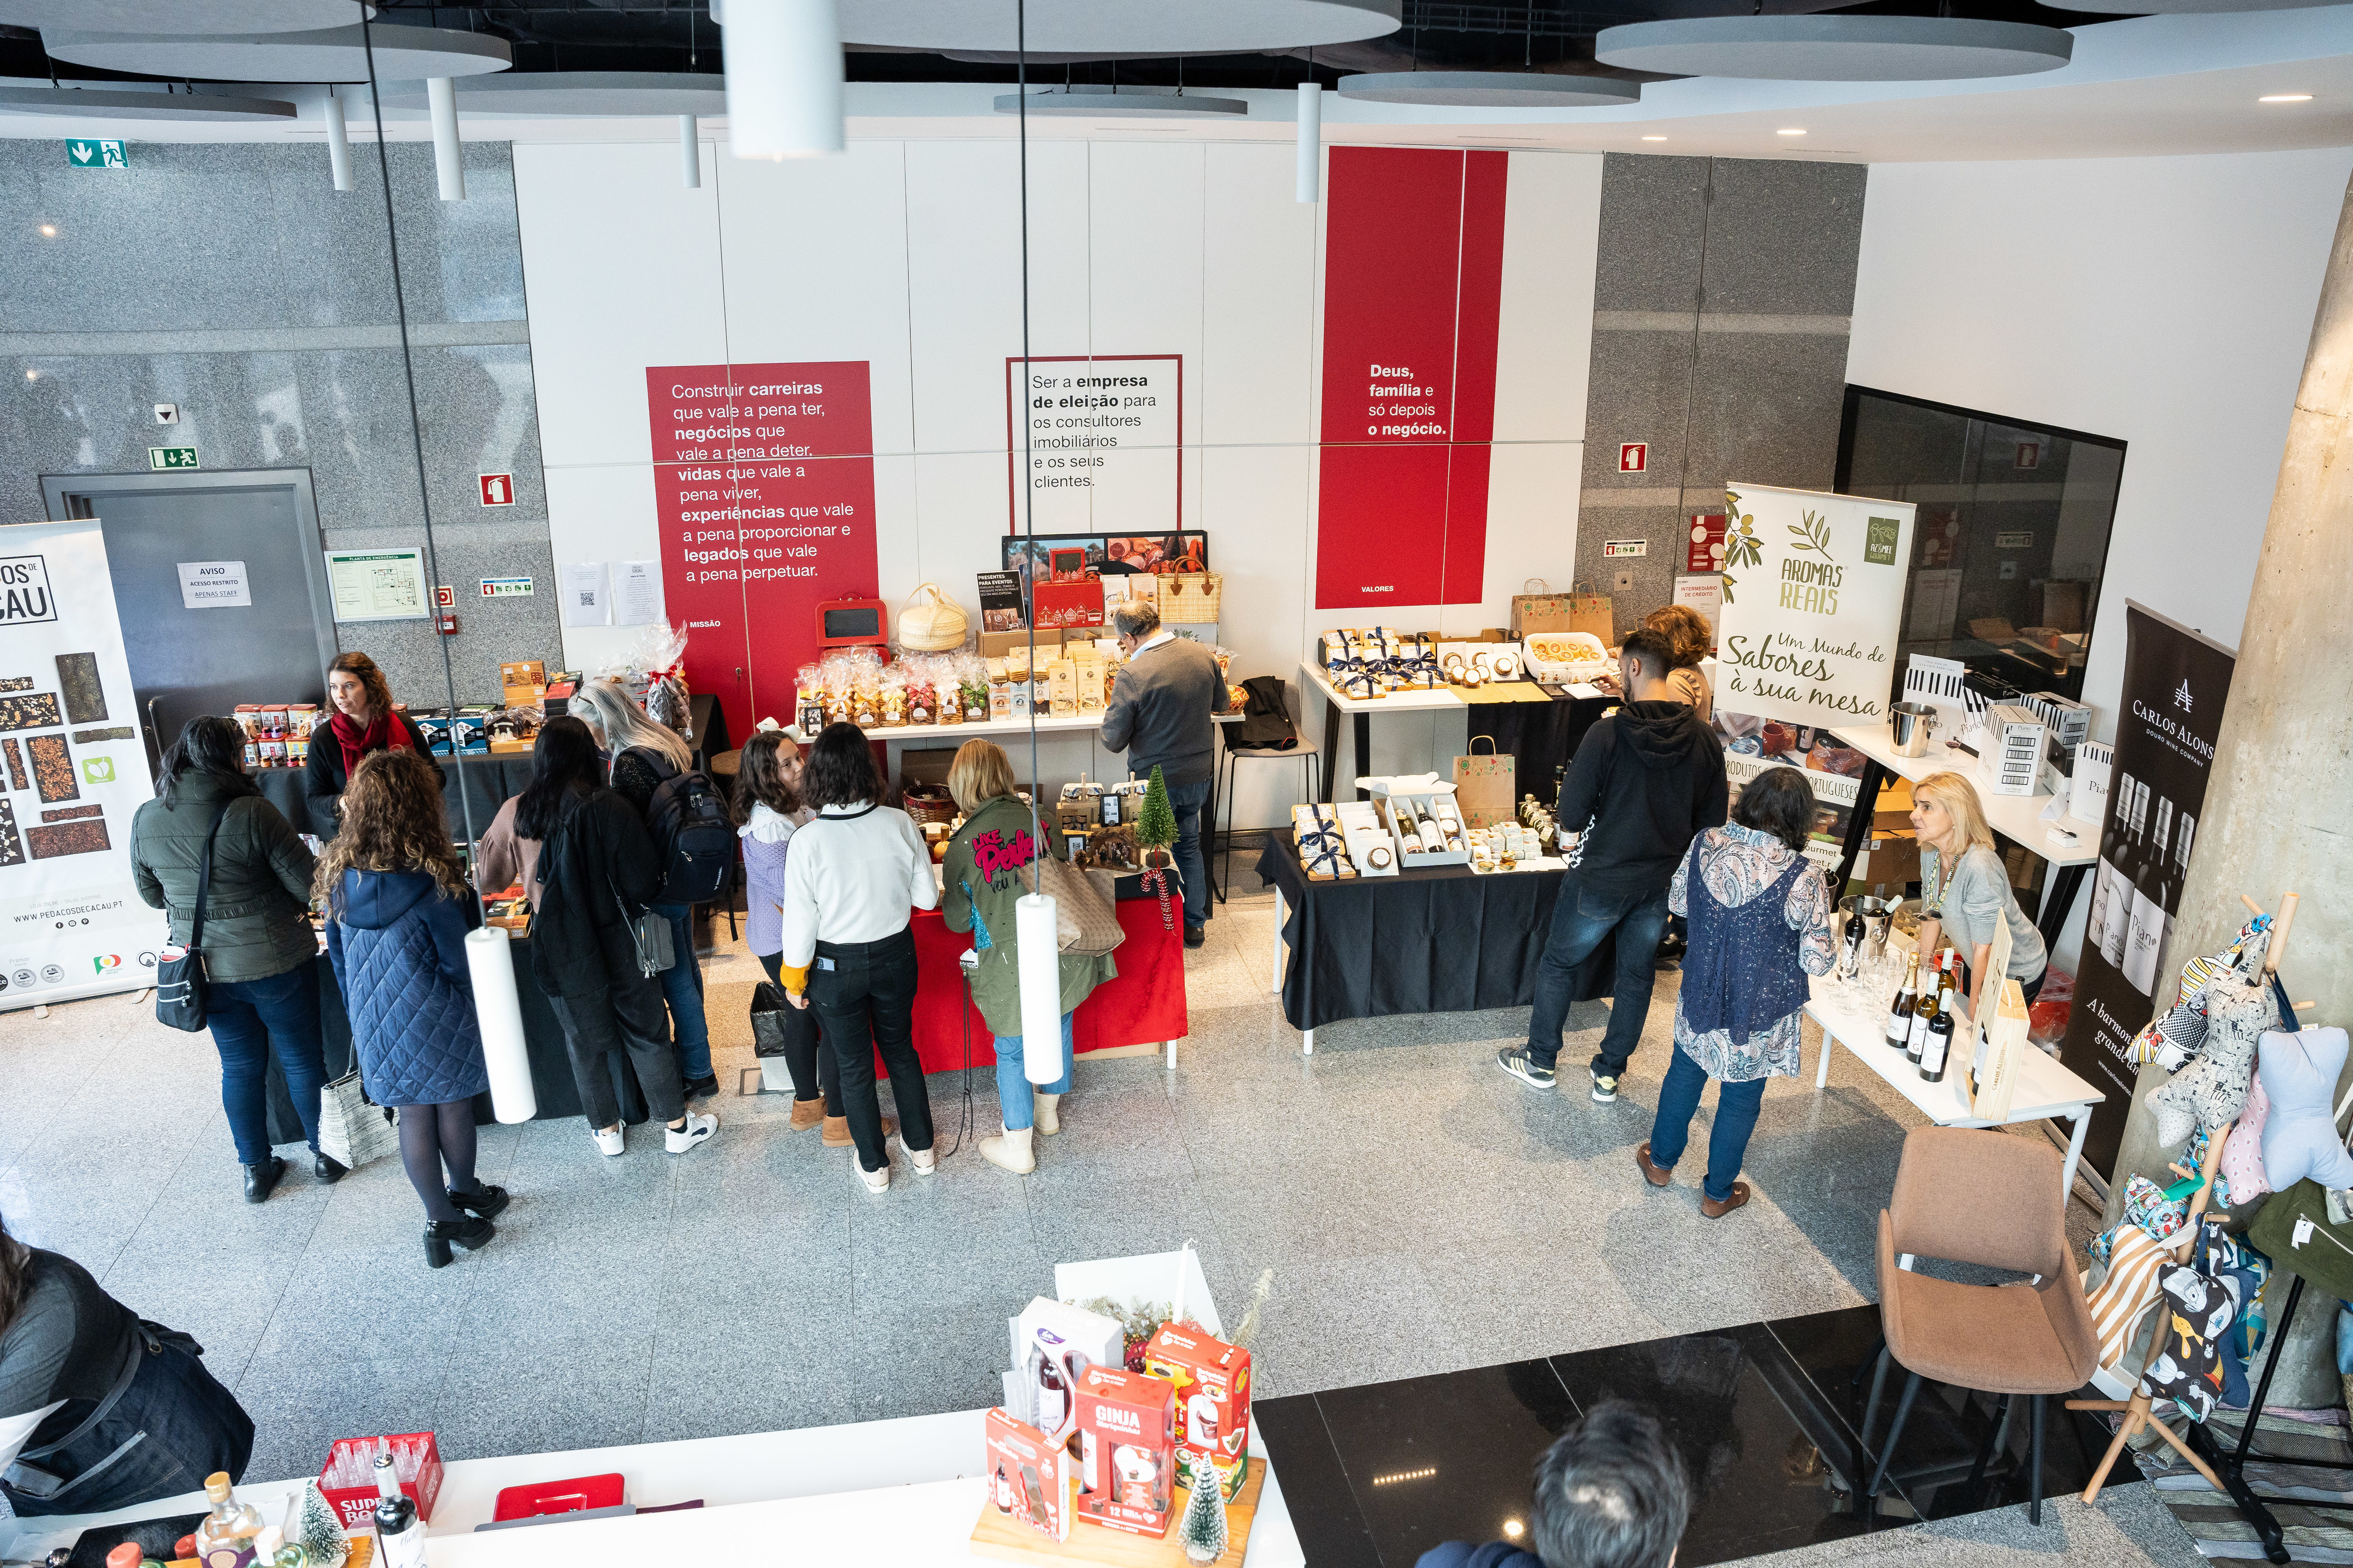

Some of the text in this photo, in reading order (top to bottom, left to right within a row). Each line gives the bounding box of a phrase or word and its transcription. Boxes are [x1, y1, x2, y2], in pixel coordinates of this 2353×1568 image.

[1371, 365, 1414, 379] Deus,
[672, 381, 823, 399] Construir carreiras
[1032, 375, 1148, 389] Ser a empresa
[1369, 384, 1434, 396] família e
[674, 402, 825, 422] que vale a pena ter,
[1033, 395, 1156, 411] de eleição para
[1369, 403, 1435, 419] só depois
[1034, 415, 1141, 428] os consultores
[1368, 422, 1446, 438] o negócio.
[675, 425, 785, 442] negócios que
[1034, 434, 1117, 449] imobiliários
[676, 447, 708, 461] vale
[712, 449, 722, 459] a
[727, 446, 765, 462] pena
[1034, 457, 1104, 468] e os seus
[678, 465, 805, 482] vidas que vale a
[1034, 475, 1095, 488] clientes.
[680, 488, 762, 504] pena viver,
[681, 503, 854, 524] experiências que vale
[683, 525, 851, 543] a pena proporcionar e
[685, 544, 817, 564] legados que vale
[1870, 552, 1891, 561] GOURMET
[0, 564, 29, 585] OS
[686, 565, 818, 584] a pena perpetuar.
[1782, 558, 1843, 588] AROMAS
[0, 586, 47, 620] AU
[1779, 582, 1838, 616] REAIS
[689, 620, 721, 628] MISSÃO
[1778, 632, 1887, 662] Um Mundo de
[1722, 634, 1834, 681] Sabores
[1731, 669, 1881, 716] à sua mesa
[2133, 699, 2176, 735] CARLOS
[1961, 721, 1982, 735] Piano
[2146, 728, 2204, 768] DOURO WINE COMPANY
[1726, 760, 1762, 779] RODUTOS
[2088, 780, 2108, 795] Pia
[972, 829, 1004, 851] LIKE
[975, 820, 1051, 883] Perfet
[1805, 845, 1837, 858] ourmet
[14, 900, 124, 923] WWW.PEDACOSDECACAU.PT
[2086, 998, 2137, 1045] A harmon
[2094, 1030, 2127, 1063] grande
[1992, 1070, 2001, 1090] CARLOS
[1997, 1049, 2005, 1070] ALONSO
[2098, 1059, 2133, 1098] www.carlosalonso.
[1095, 1404, 1141, 1429] GINJA
[1095, 1419, 1141, 1435] Mariquinhas
[340, 1497, 382, 1512] SUPE
[1109, 1506, 1121, 1517] 12
